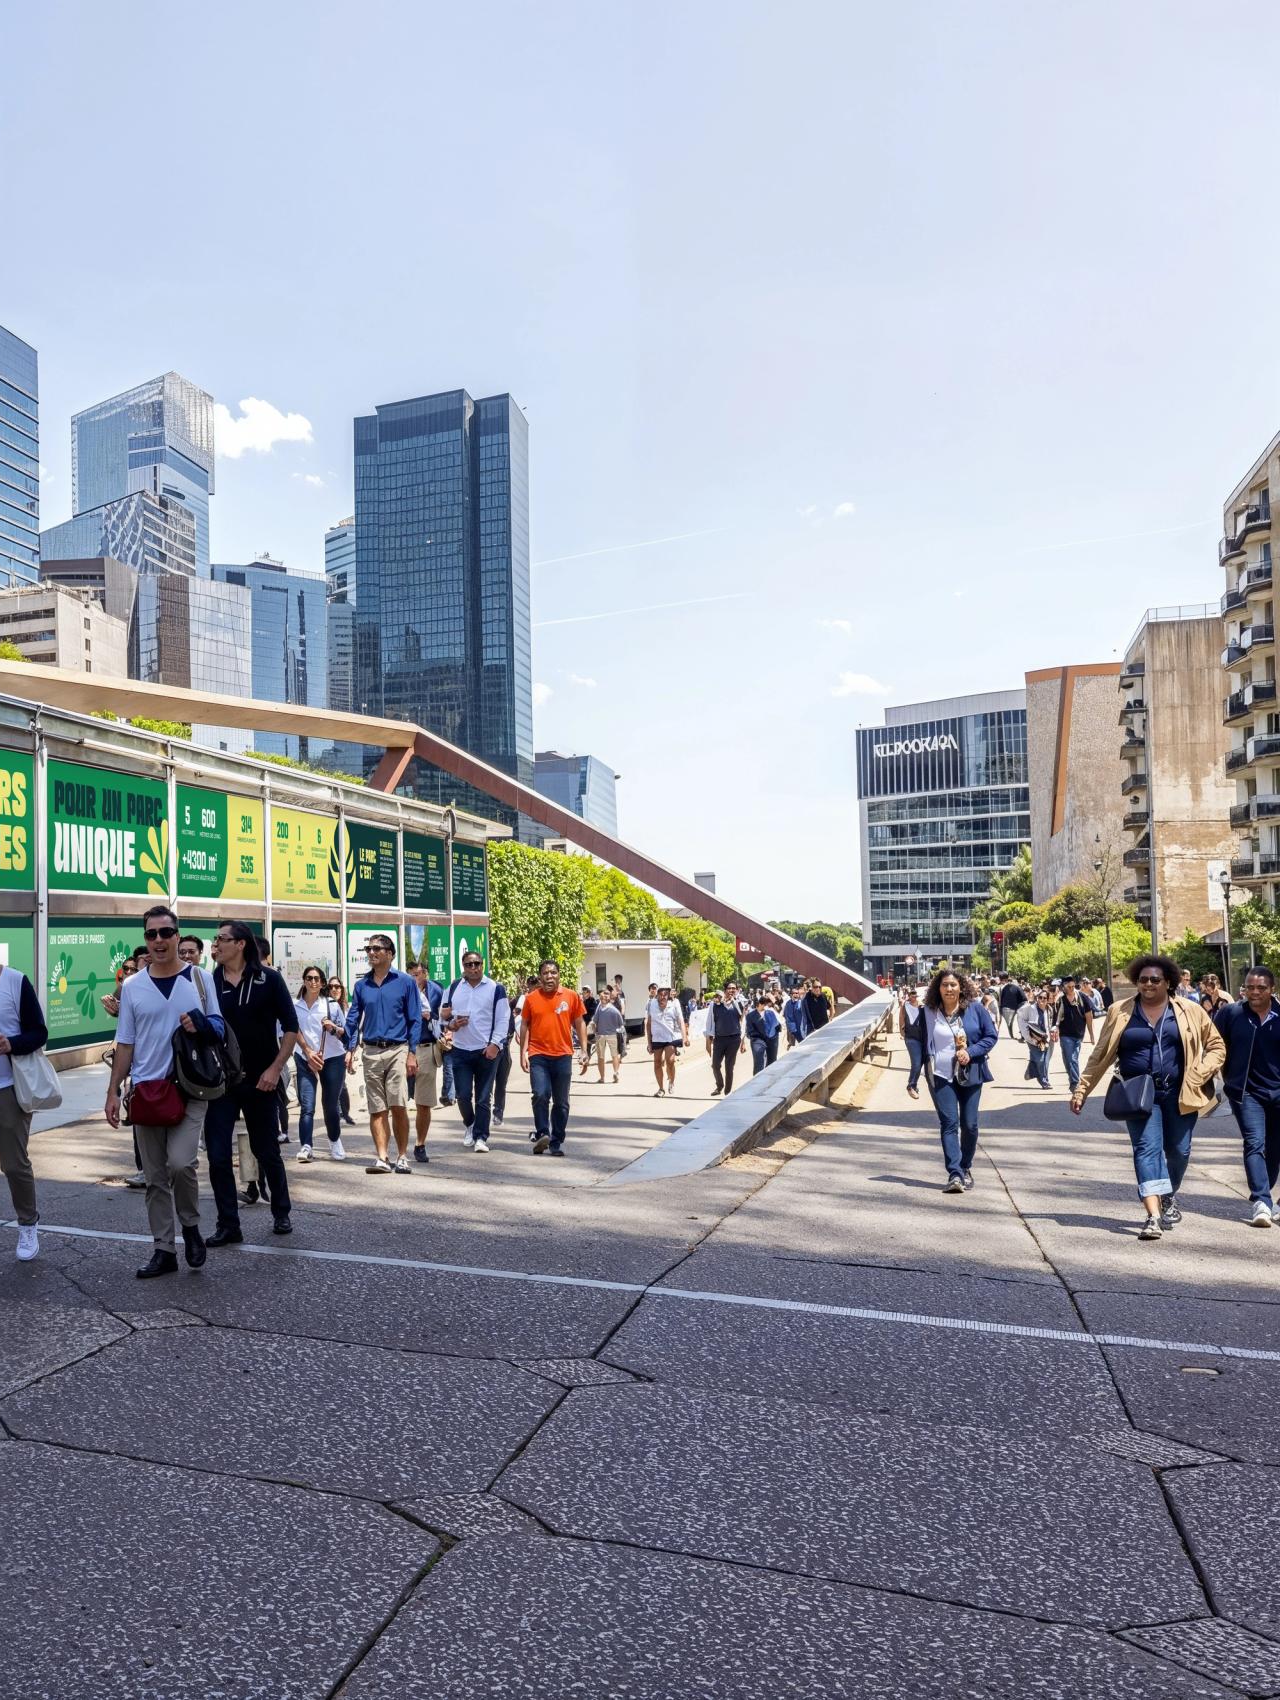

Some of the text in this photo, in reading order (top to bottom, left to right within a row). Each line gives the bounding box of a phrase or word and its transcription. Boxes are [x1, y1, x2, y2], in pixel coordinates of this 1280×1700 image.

[54, 779, 163, 828] POUR UN PARC
[185, 805, 191, 826] 5
[201, 808, 216, 829] 600
[241, 815, 253, 834] 314
[276, 821, 289, 839] 200
[317, 828, 322, 845] 6
[54, 821, 136, 886] UNIQUE
[240, 854, 254, 874] 535
[306, 863, 316, 880] 100
